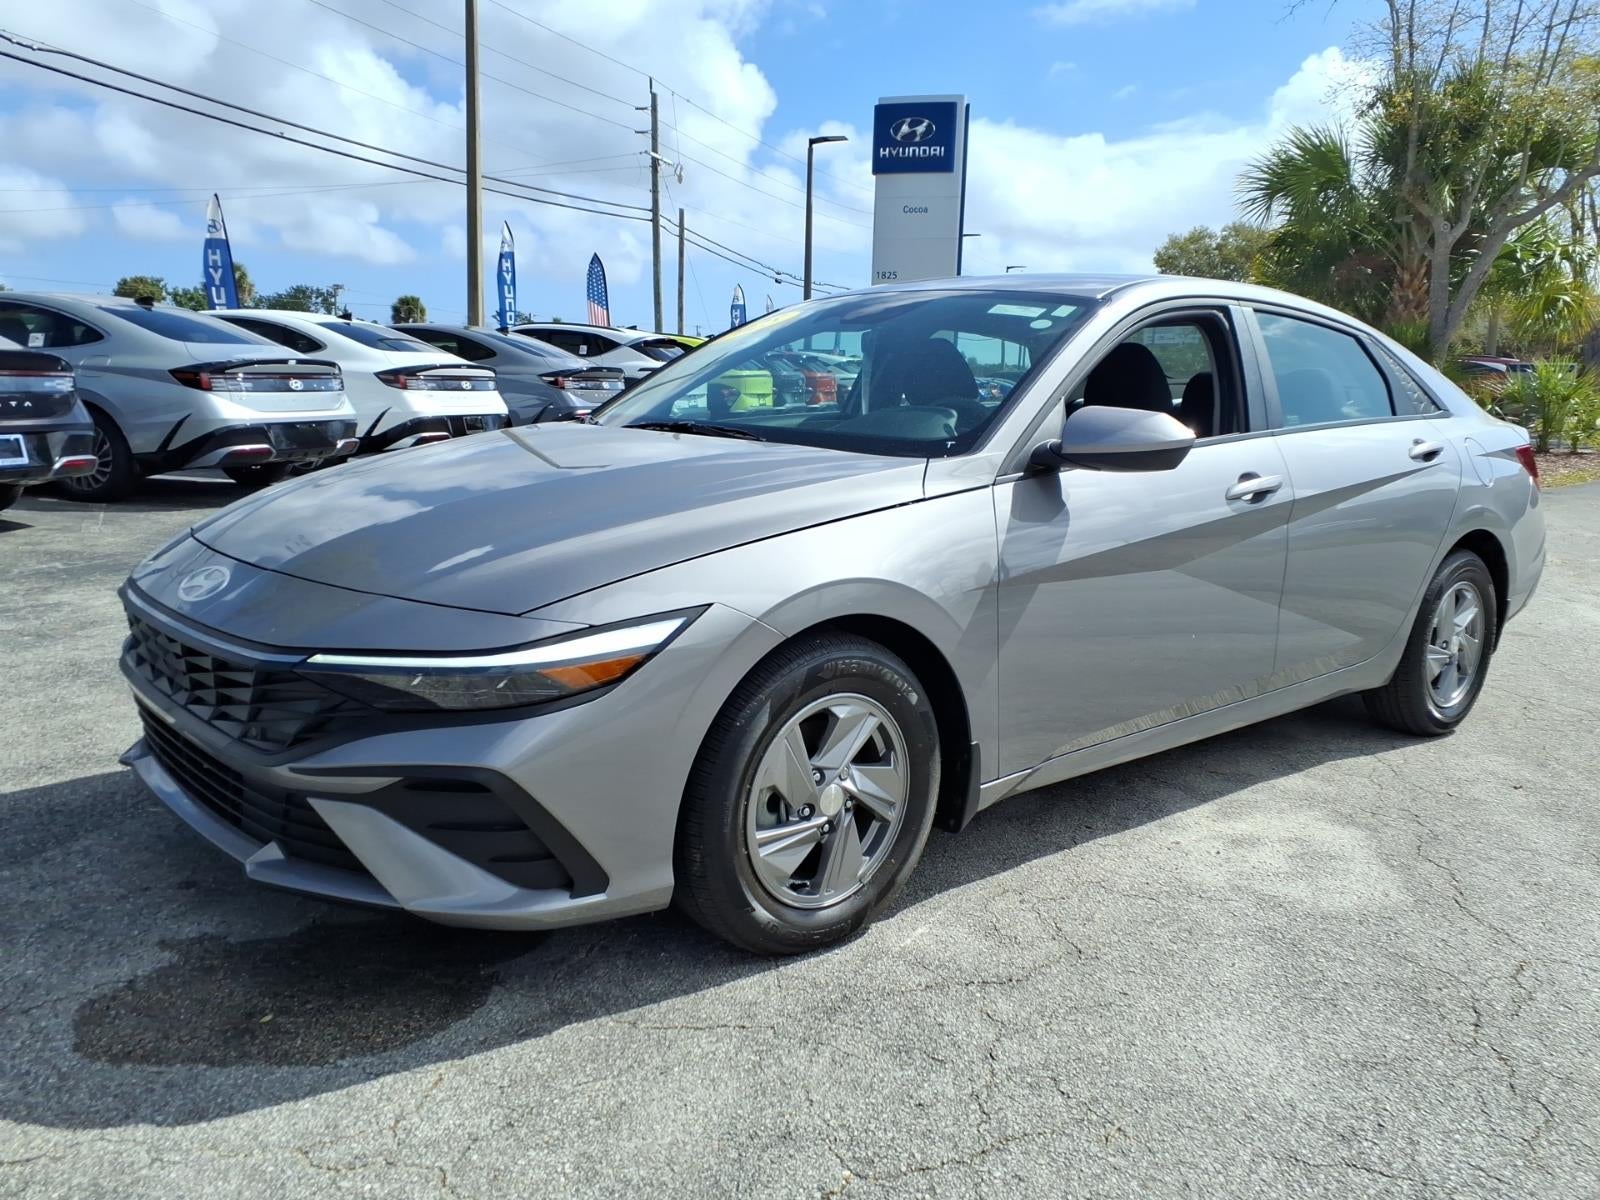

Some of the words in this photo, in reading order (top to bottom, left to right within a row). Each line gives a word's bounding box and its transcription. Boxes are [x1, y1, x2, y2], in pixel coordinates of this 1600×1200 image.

[880, 146, 945, 158] HYUNDAI
[903, 205, 928, 214] Cocoa
[208, 248, 227, 310] HYU
[876, 271, 898, 280] 1825
[501, 258, 515, 327] HYUND
